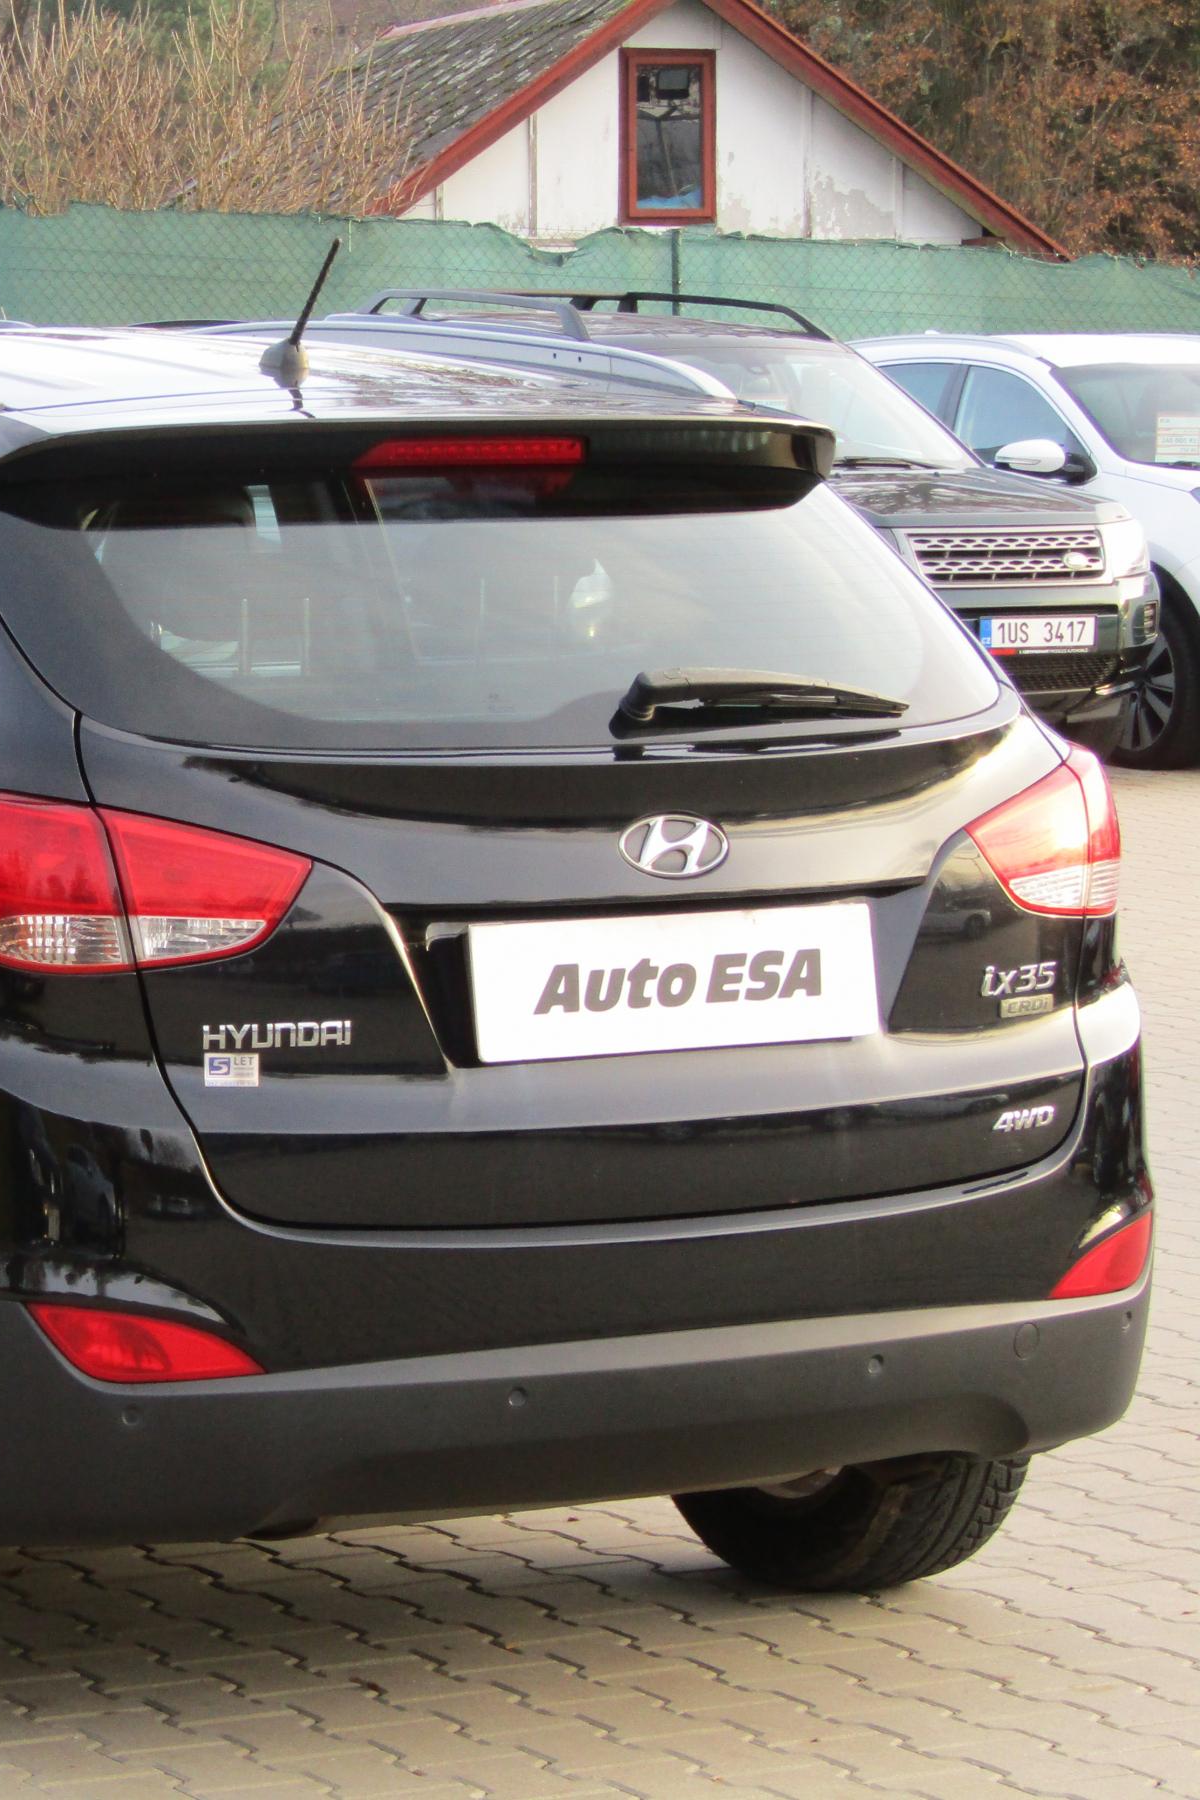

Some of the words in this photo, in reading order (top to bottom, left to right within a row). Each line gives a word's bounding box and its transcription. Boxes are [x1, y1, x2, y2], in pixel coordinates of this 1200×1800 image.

[997, 620, 1029, 644] 1US
[1043, 620, 1087, 643] 3417
[533, 957, 697, 1015] Auto
[705, 948, 822, 1004] ESA
[981, 961, 1057, 997] ix35
[202, 1020, 352, 1050] HYUNDAI
[233, 1056, 255, 1066] LET
[991, 1105, 1055, 1133] 4WD
